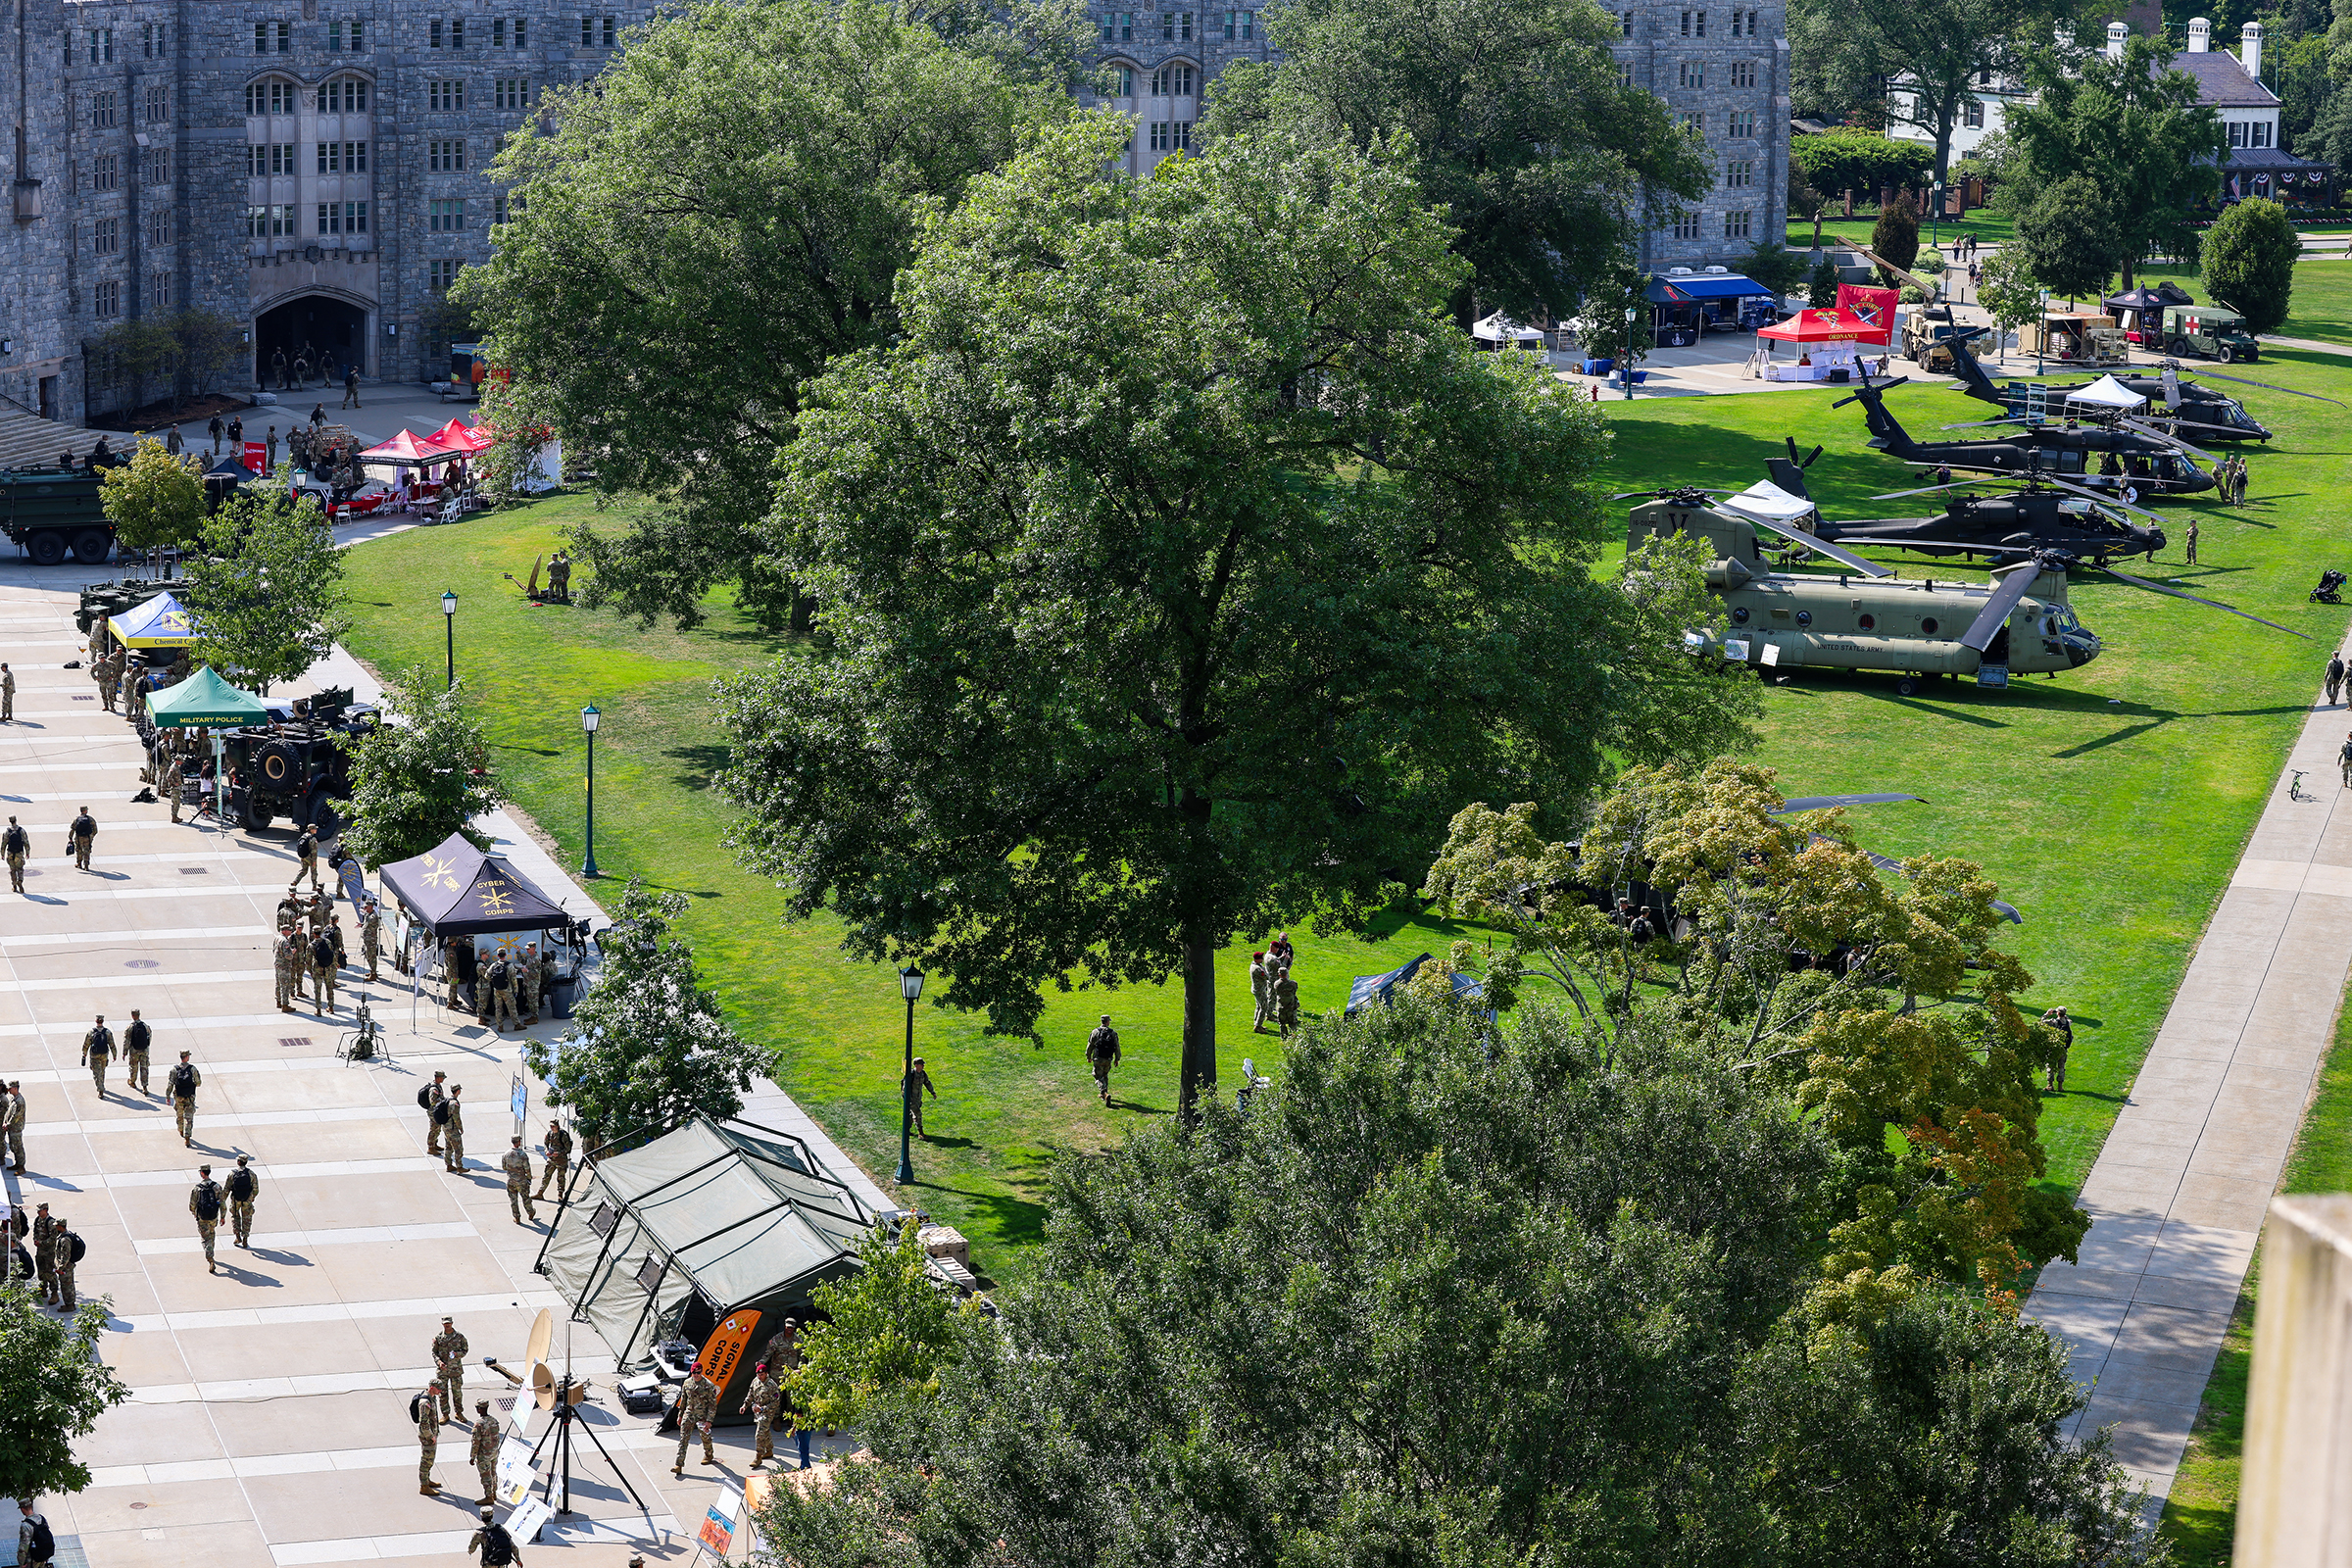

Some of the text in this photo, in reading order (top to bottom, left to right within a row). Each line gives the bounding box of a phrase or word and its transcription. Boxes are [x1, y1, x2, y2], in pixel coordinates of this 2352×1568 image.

[420, 854, 436, 867] CYBER
[443, 876, 461, 892] CORPS
[476, 880, 506, 889] CYBER
[706, 1340, 727, 1377] CORPS
[716, 1342, 740, 1382] SIGNAL
